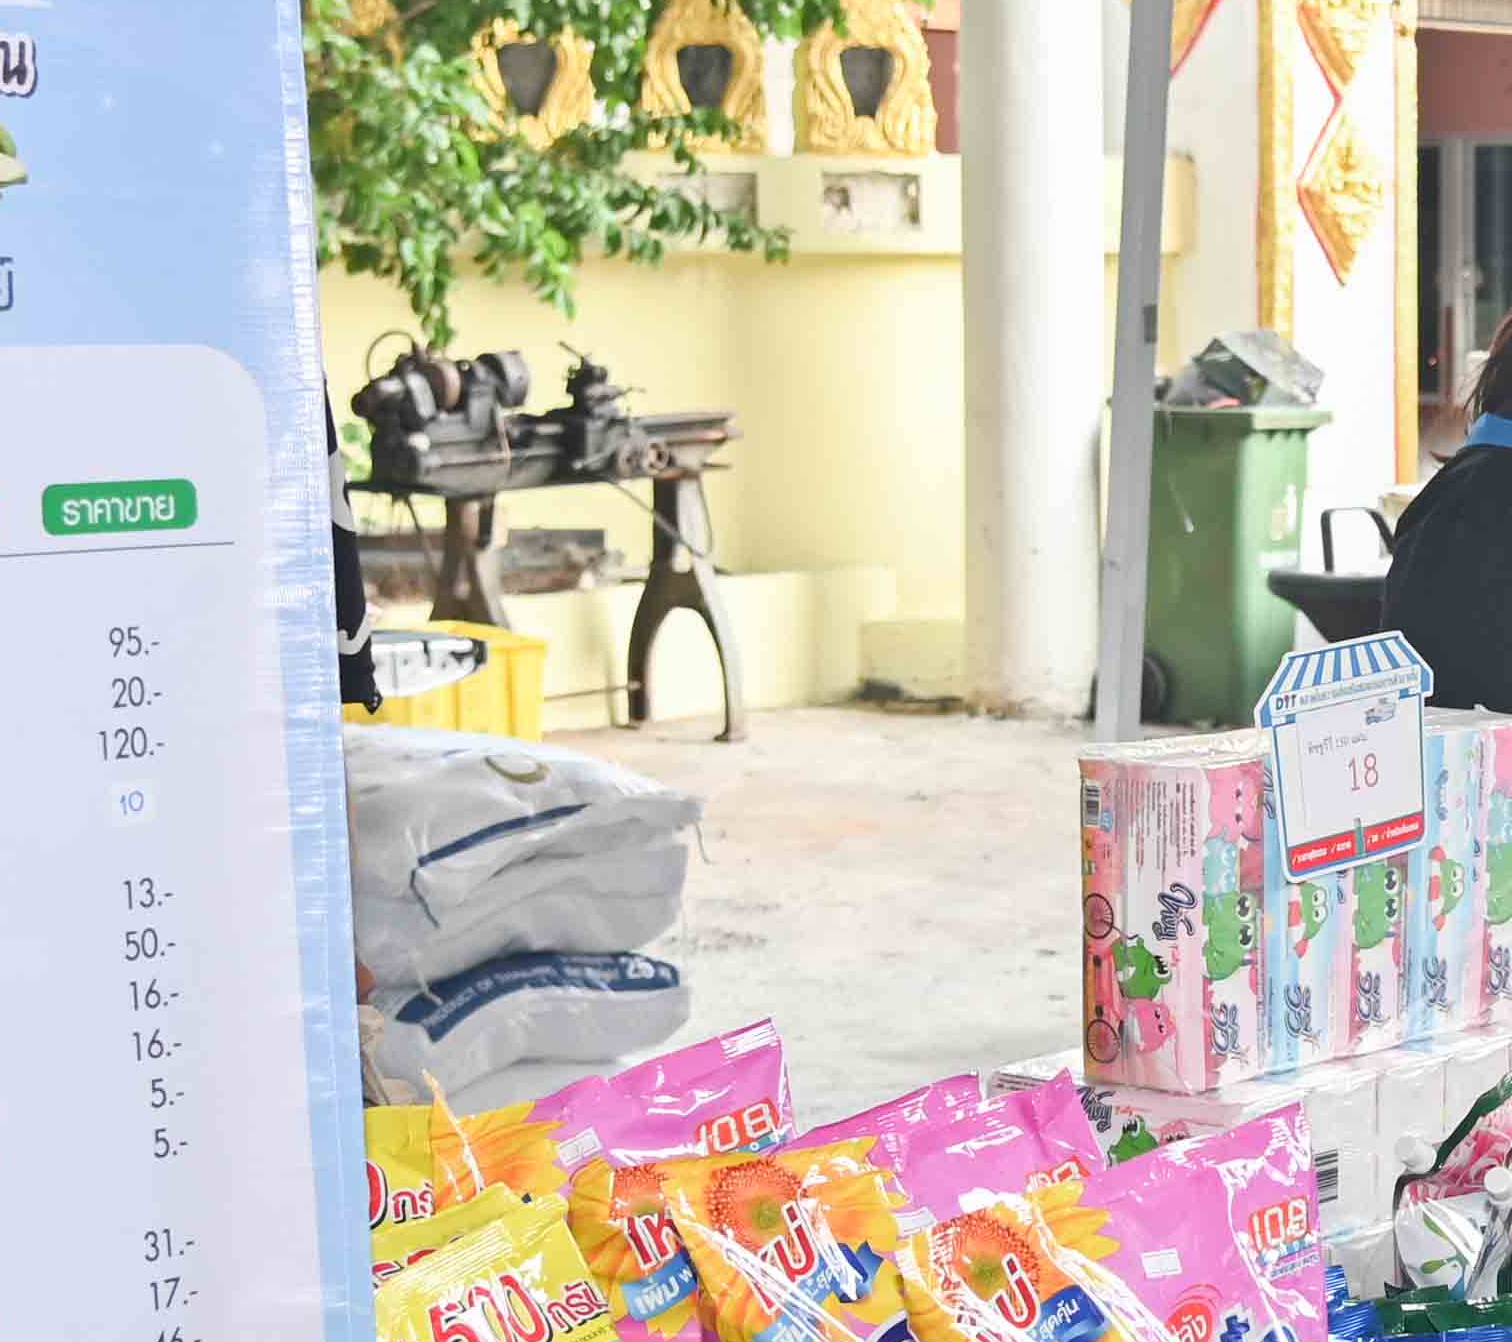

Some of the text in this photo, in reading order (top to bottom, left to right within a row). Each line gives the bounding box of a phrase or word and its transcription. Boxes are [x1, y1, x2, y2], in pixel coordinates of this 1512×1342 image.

[61, 489, 176, 527] ราคาขาย
[109, 626, 161, 658] 95.-
[97, 728, 165, 763] 120.-
[1347, 753, 1380, 792] 18
[119, 789, 145, 815] 10
[124, 929, 177, 961] 50.-
[143, 1229, 195, 1262] 31.-
